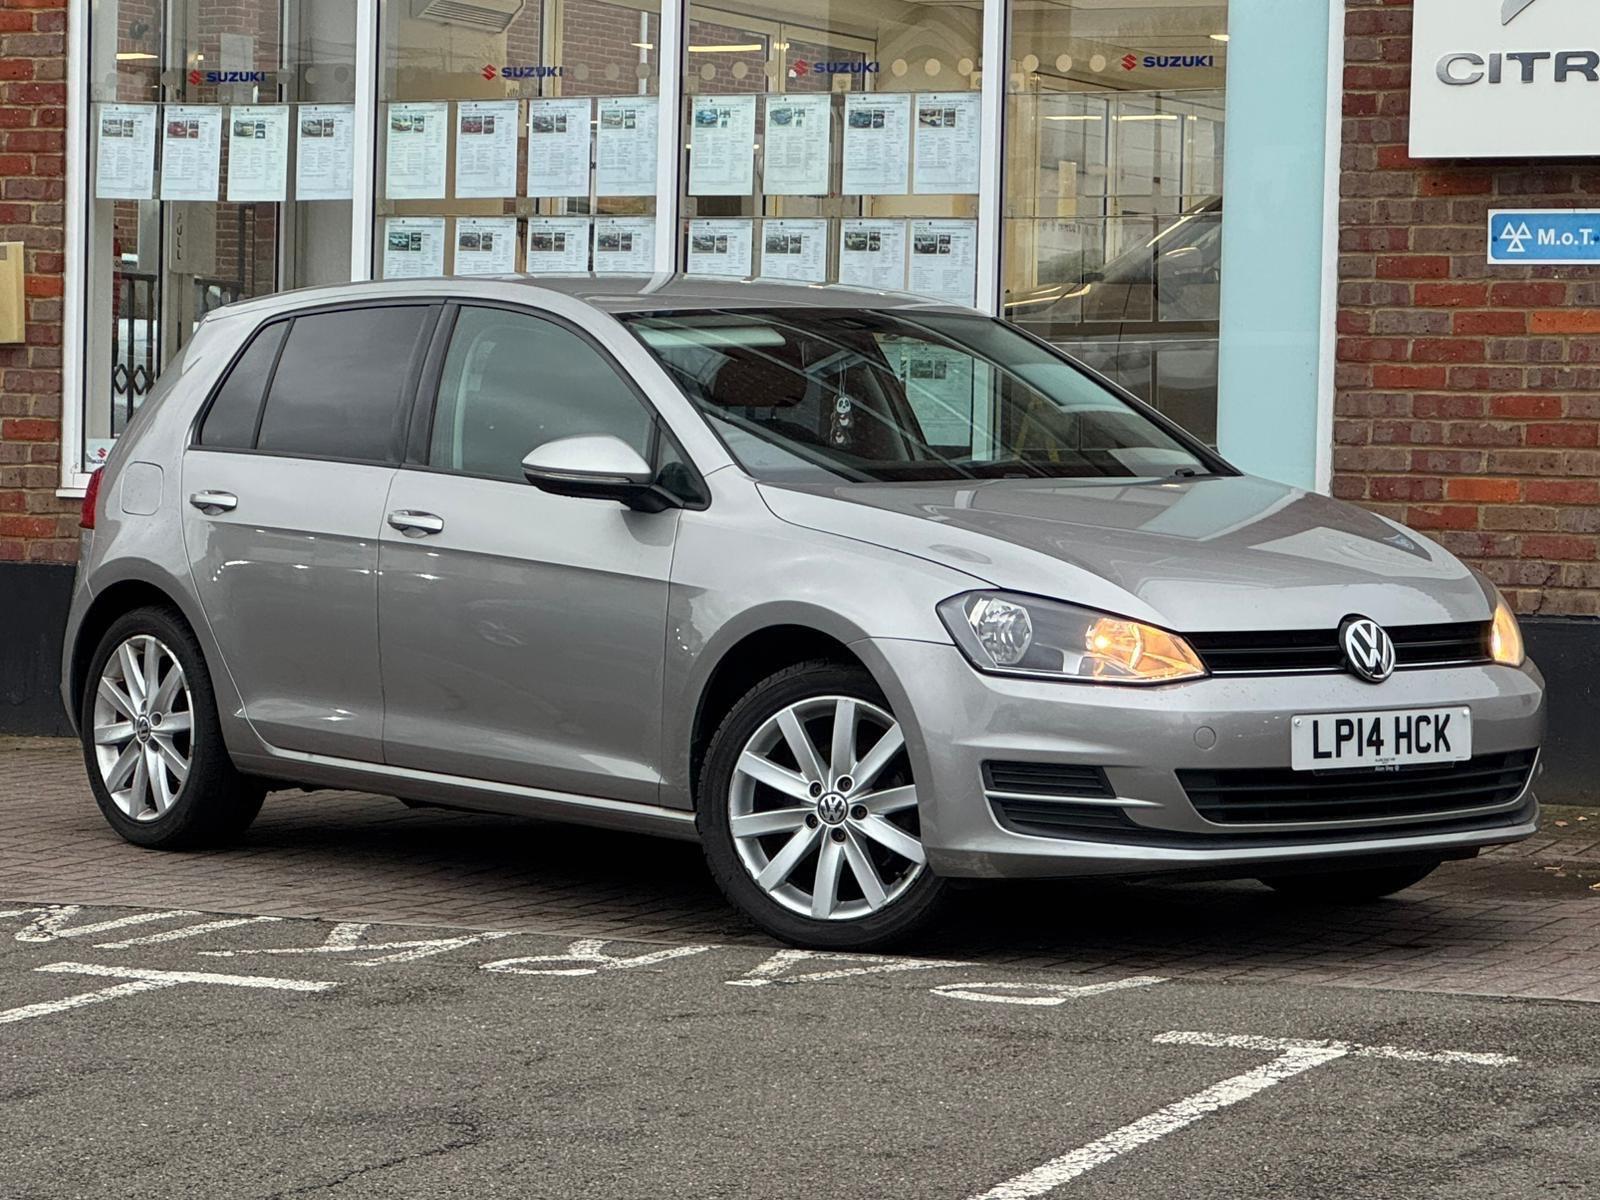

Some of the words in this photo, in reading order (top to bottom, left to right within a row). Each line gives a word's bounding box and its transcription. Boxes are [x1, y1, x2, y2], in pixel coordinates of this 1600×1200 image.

[814, 62, 880, 74] SUZUKI
[1144, 56, 1214, 68] SUZUKI
[501, 66, 564, 79] SUZUKI
[1436, 51, 1600, 87] CITR
[206, 72, 266, 83] SUZUKI
[1313, 718, 1384, 759] LP14
[1395, 714, 1452, 754] HCK
